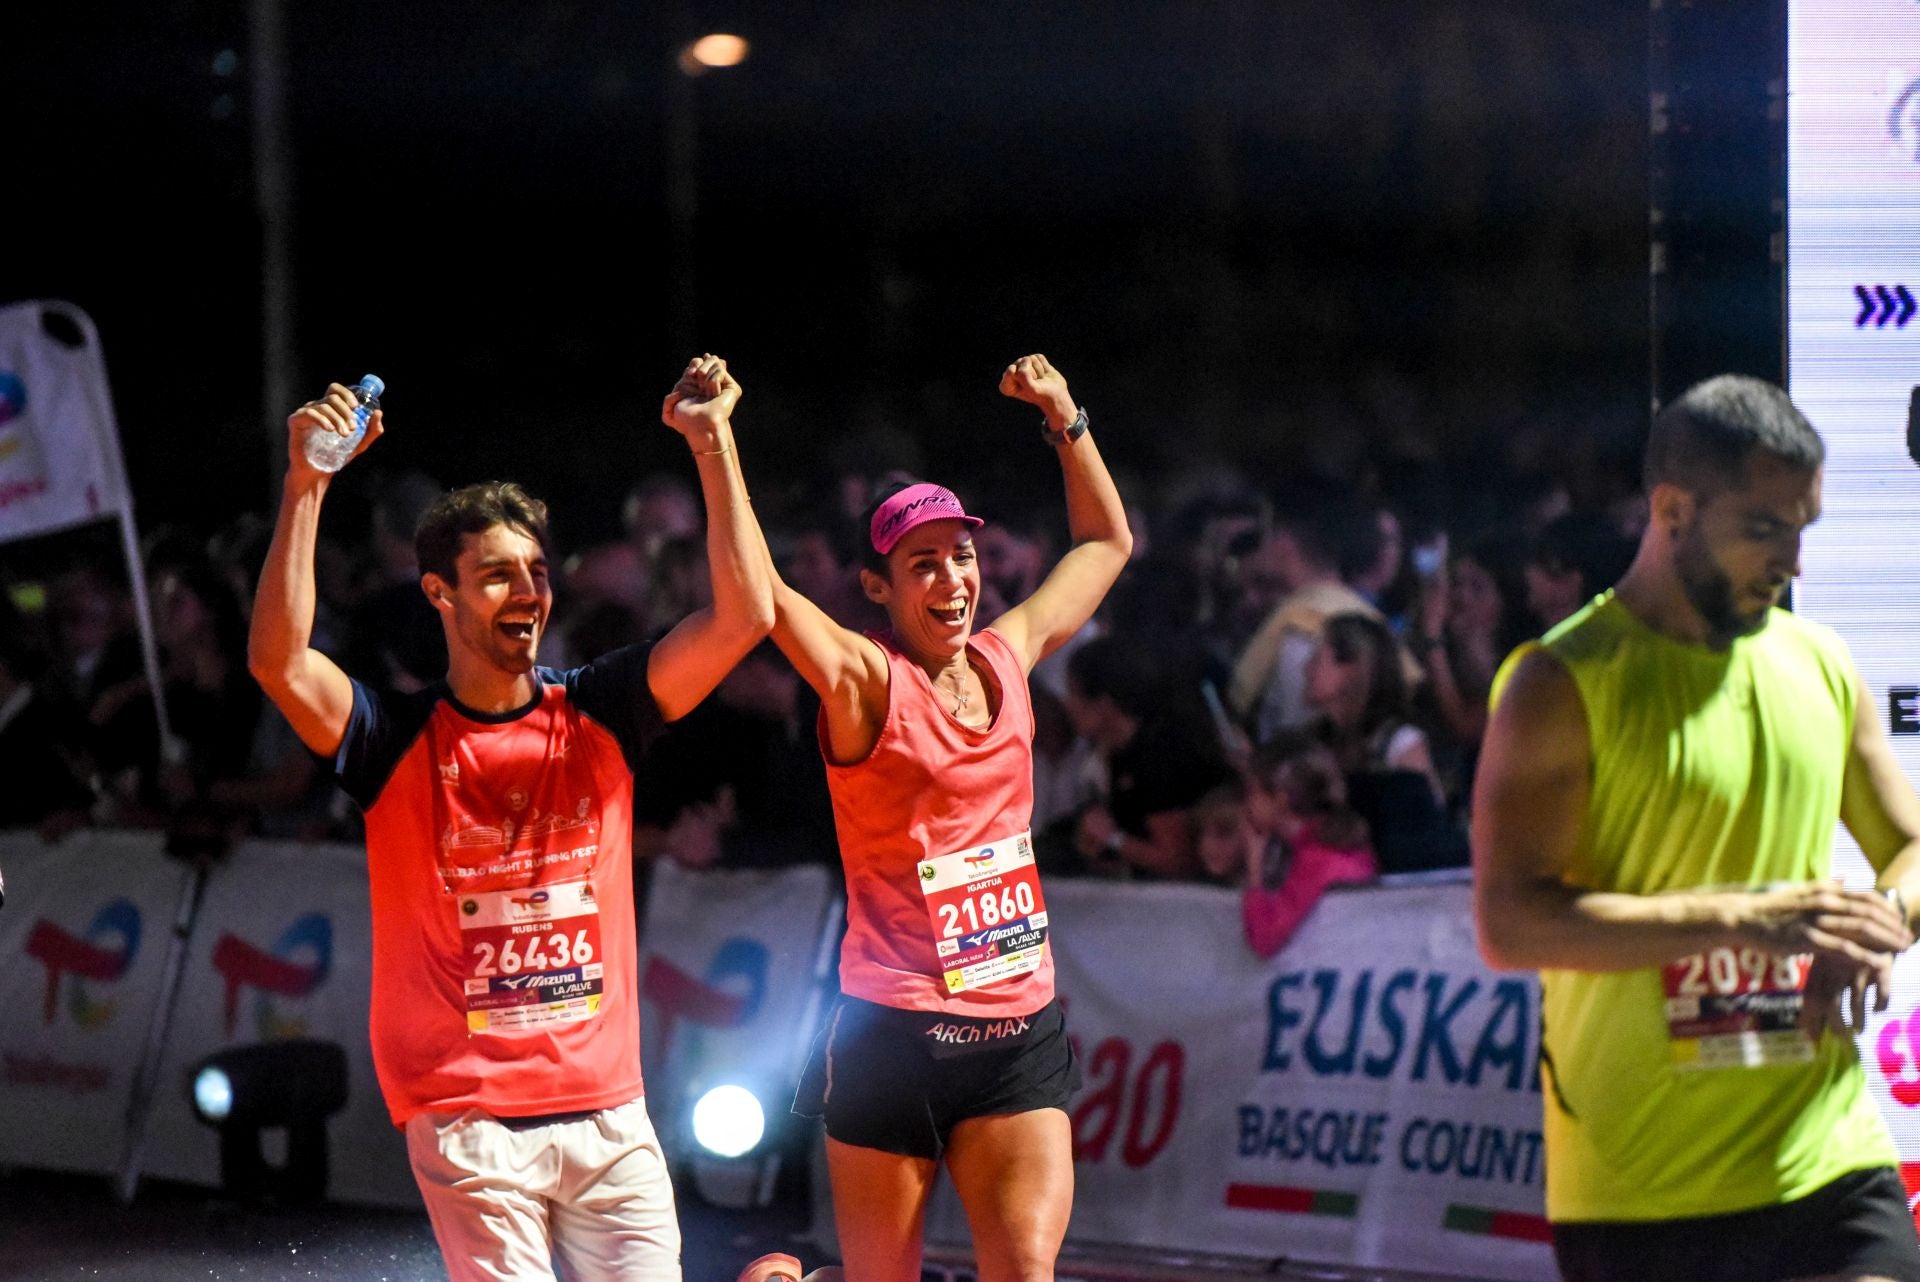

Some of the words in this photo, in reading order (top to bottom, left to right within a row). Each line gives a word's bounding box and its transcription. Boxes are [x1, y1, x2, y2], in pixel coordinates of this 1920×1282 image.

[489, 861, 521, 875] NIGHT
[571, 845, 598, 859] FEST
[967, 877, 1003, 892] IGARTUA
[512, 922, 553, 934] RUBENS
[938, 881, 1035, 938] 21860
[473, 930, 593, 976] 26436
[984, 1016, 1031, 1041] MAX
[1261, 968, 1542, 1095] EUSKA
[1238, 1104, 1389, 1169] BASQUE
[1400, 1117, 1545, 1186] COUNT
